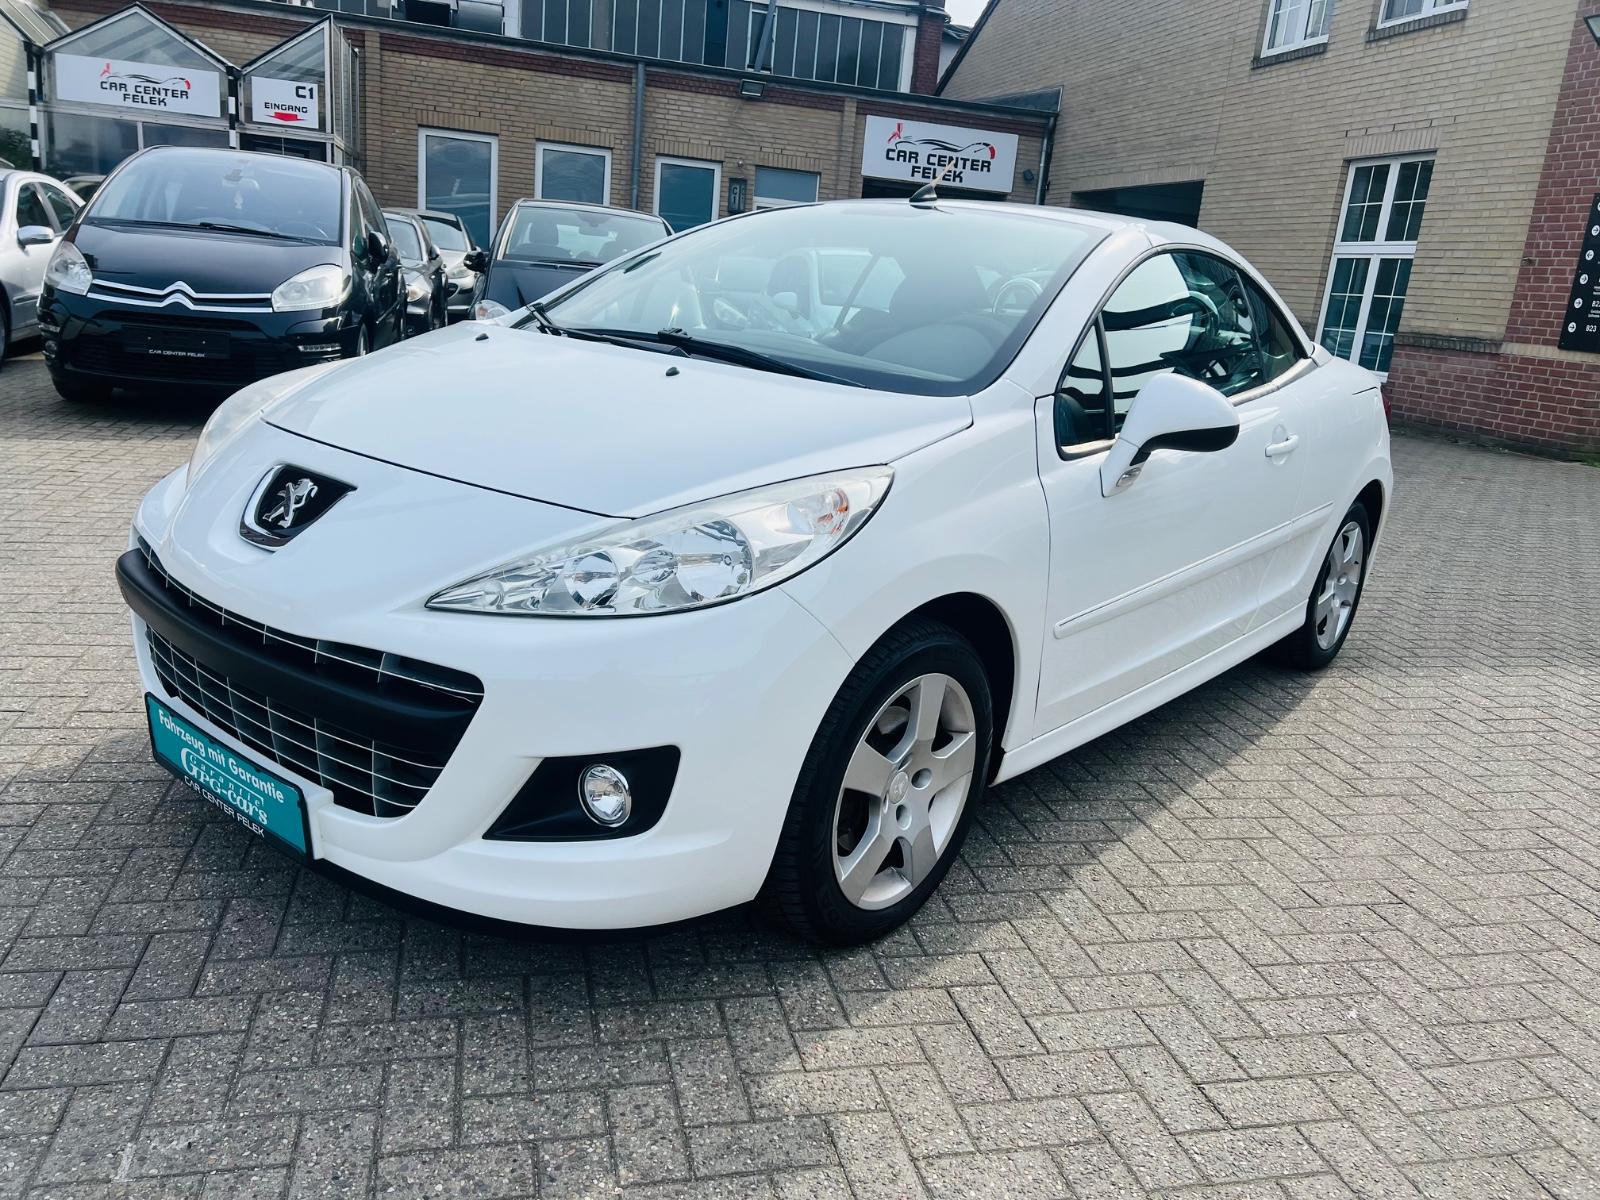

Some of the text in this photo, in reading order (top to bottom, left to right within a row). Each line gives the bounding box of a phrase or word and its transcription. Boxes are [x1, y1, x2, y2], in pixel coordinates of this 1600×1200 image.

[100, 80, 189, 100] CAR CENTER
[295, 85, 314, 100] C1
[123, 93, 167, 107] FELEK
[264, 101, 308, 114] EINGANG
[885, 148, 992, 173] CAR CENTER
[911, 165, 964, 183] FELEK
[158, 708, 285, 804] Fahrzeug mit Garantie
[184, 775, 265, 838] CAR CENTER FELEK
